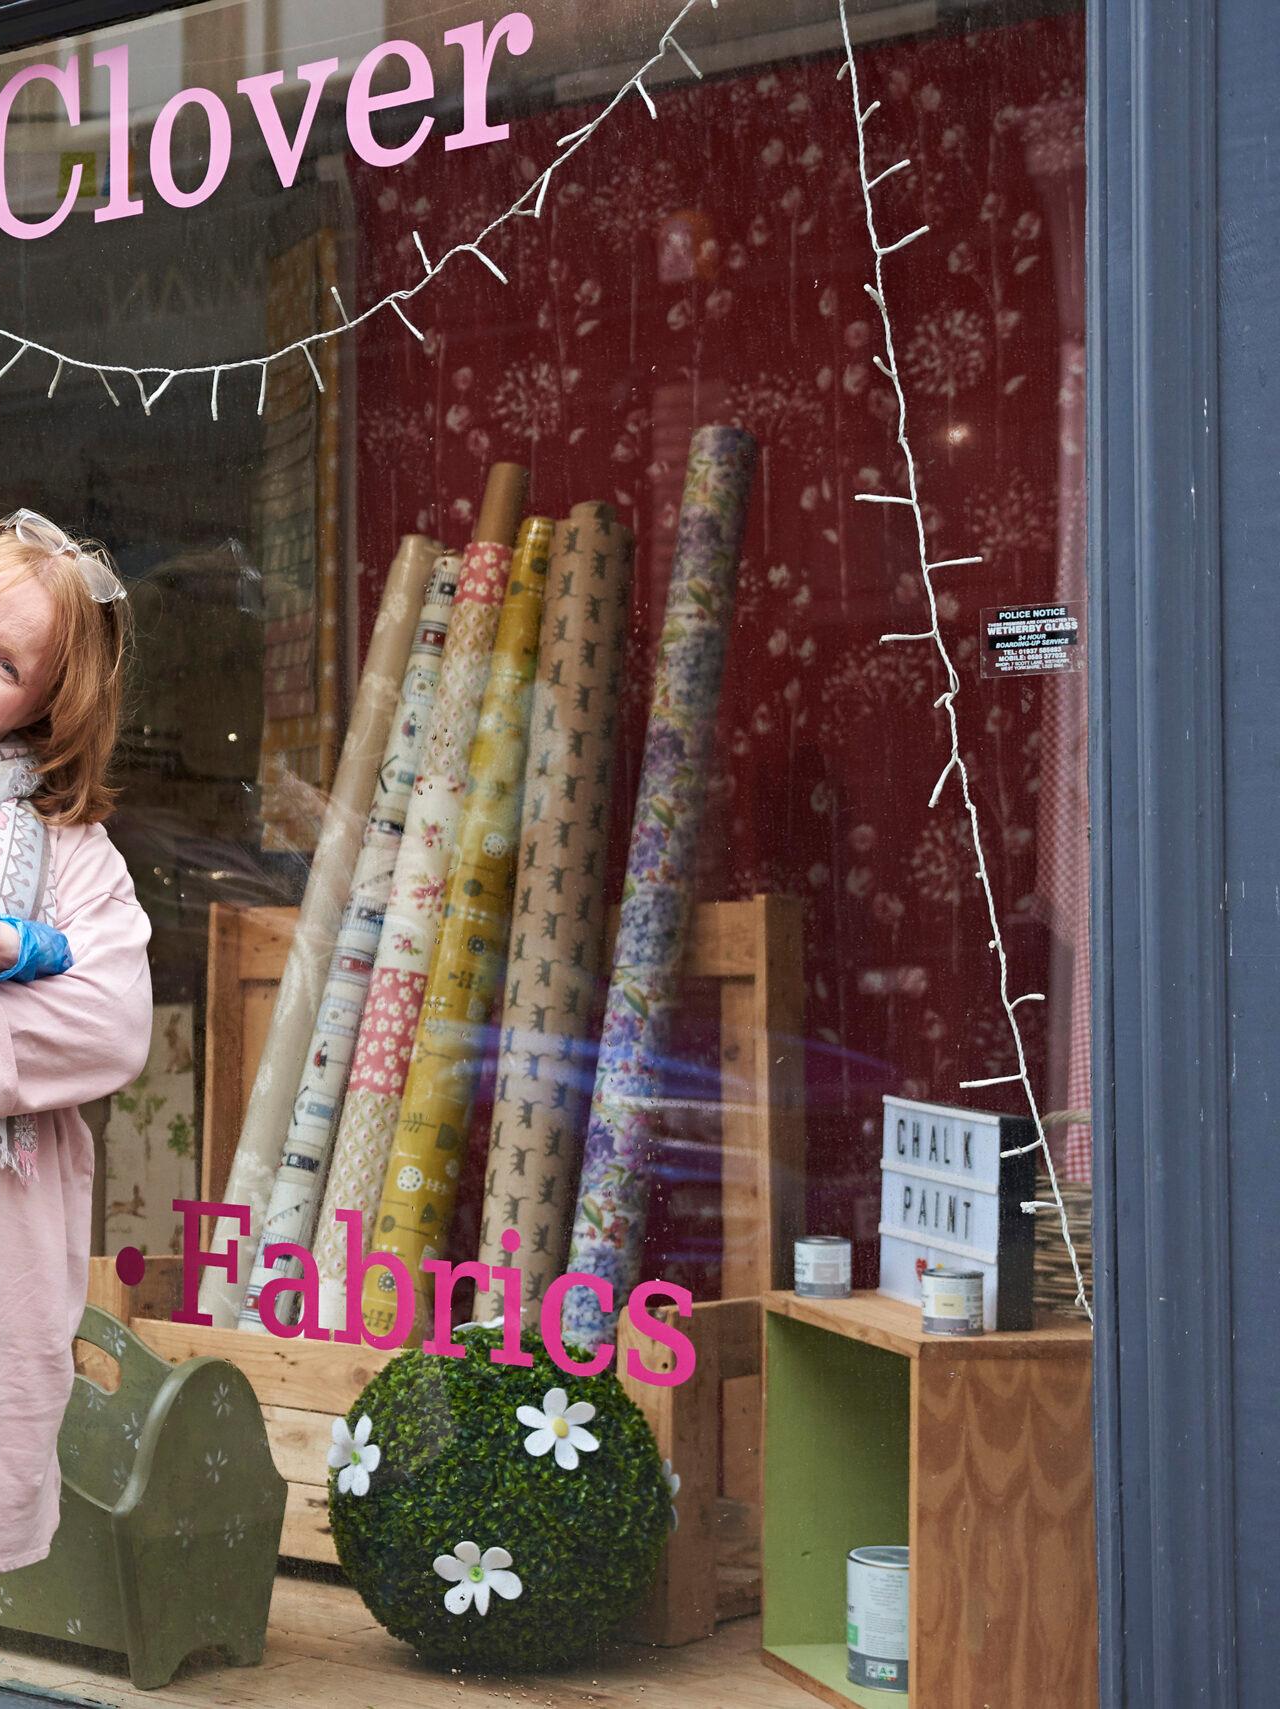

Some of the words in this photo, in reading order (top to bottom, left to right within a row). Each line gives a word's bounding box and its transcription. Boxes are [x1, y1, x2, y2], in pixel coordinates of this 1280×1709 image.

[987, 625, 1043, 635] WETHERBY
[1045, 622, 1078, 631] GLASS
[999, 611, 1030, 619] POLICE
[1033, 608, 1065, 617] NOTICE
[896, 1119, 972, 1168] CHALK
[902, 1186, 971, 1240] PAINT
[171, 1200, 696, 1386] Fabrics
